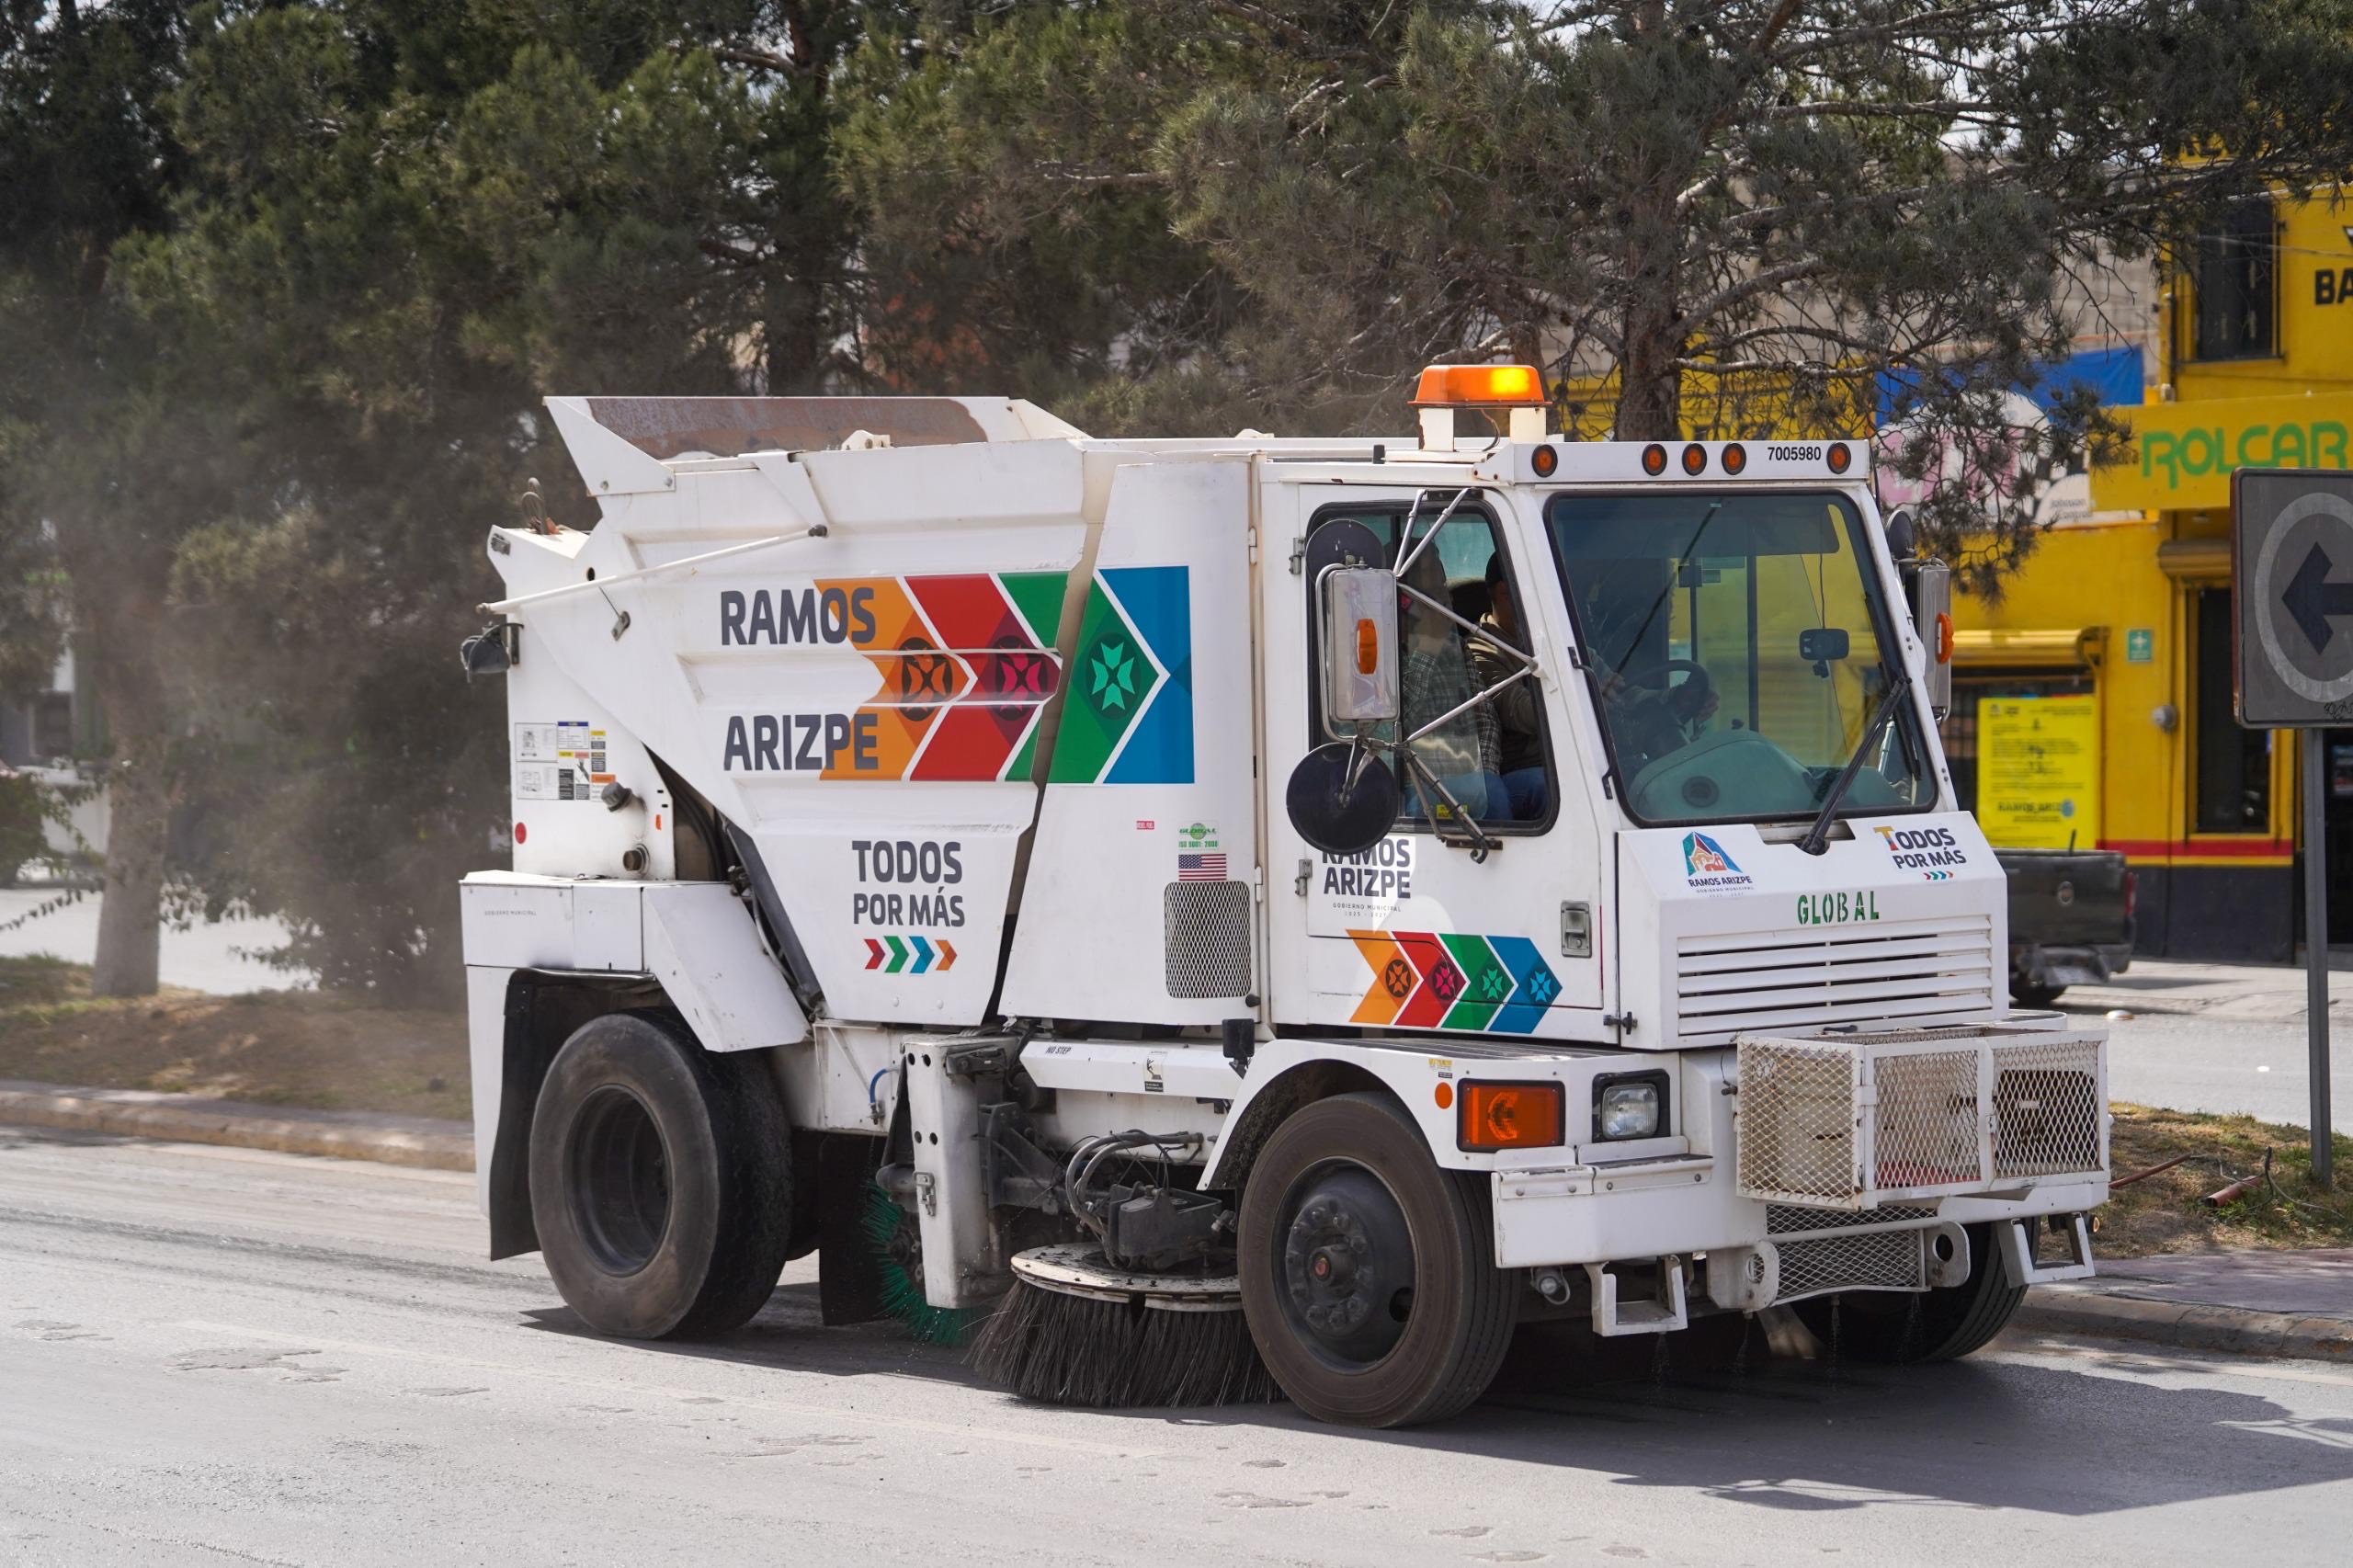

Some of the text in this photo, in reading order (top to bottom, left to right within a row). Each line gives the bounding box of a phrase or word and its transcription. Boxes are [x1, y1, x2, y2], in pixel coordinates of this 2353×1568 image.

[1768, 447, 1822, 460] 7005980
[2143, 421, 2348, 490] ROLCAR
[721, 586, 876, 645] RAMOS
[723, 713, 879, 771] ARIZPE
[1872, 825, 1956, 851] TODOS
[851, 840, 962, 884] TODOS
[1893, 846, 1967, 869] POR MÁS
[1324, 867, 1411, 899] ARIZPE
[1688, 875, 1753, 888] RAMOS ARIZPE
[853, 886, 965, 927] POR MÁS
[1797, 891, 1880, 925] GLOBAL
[1056, 1046, 1072, 1054] STEP
